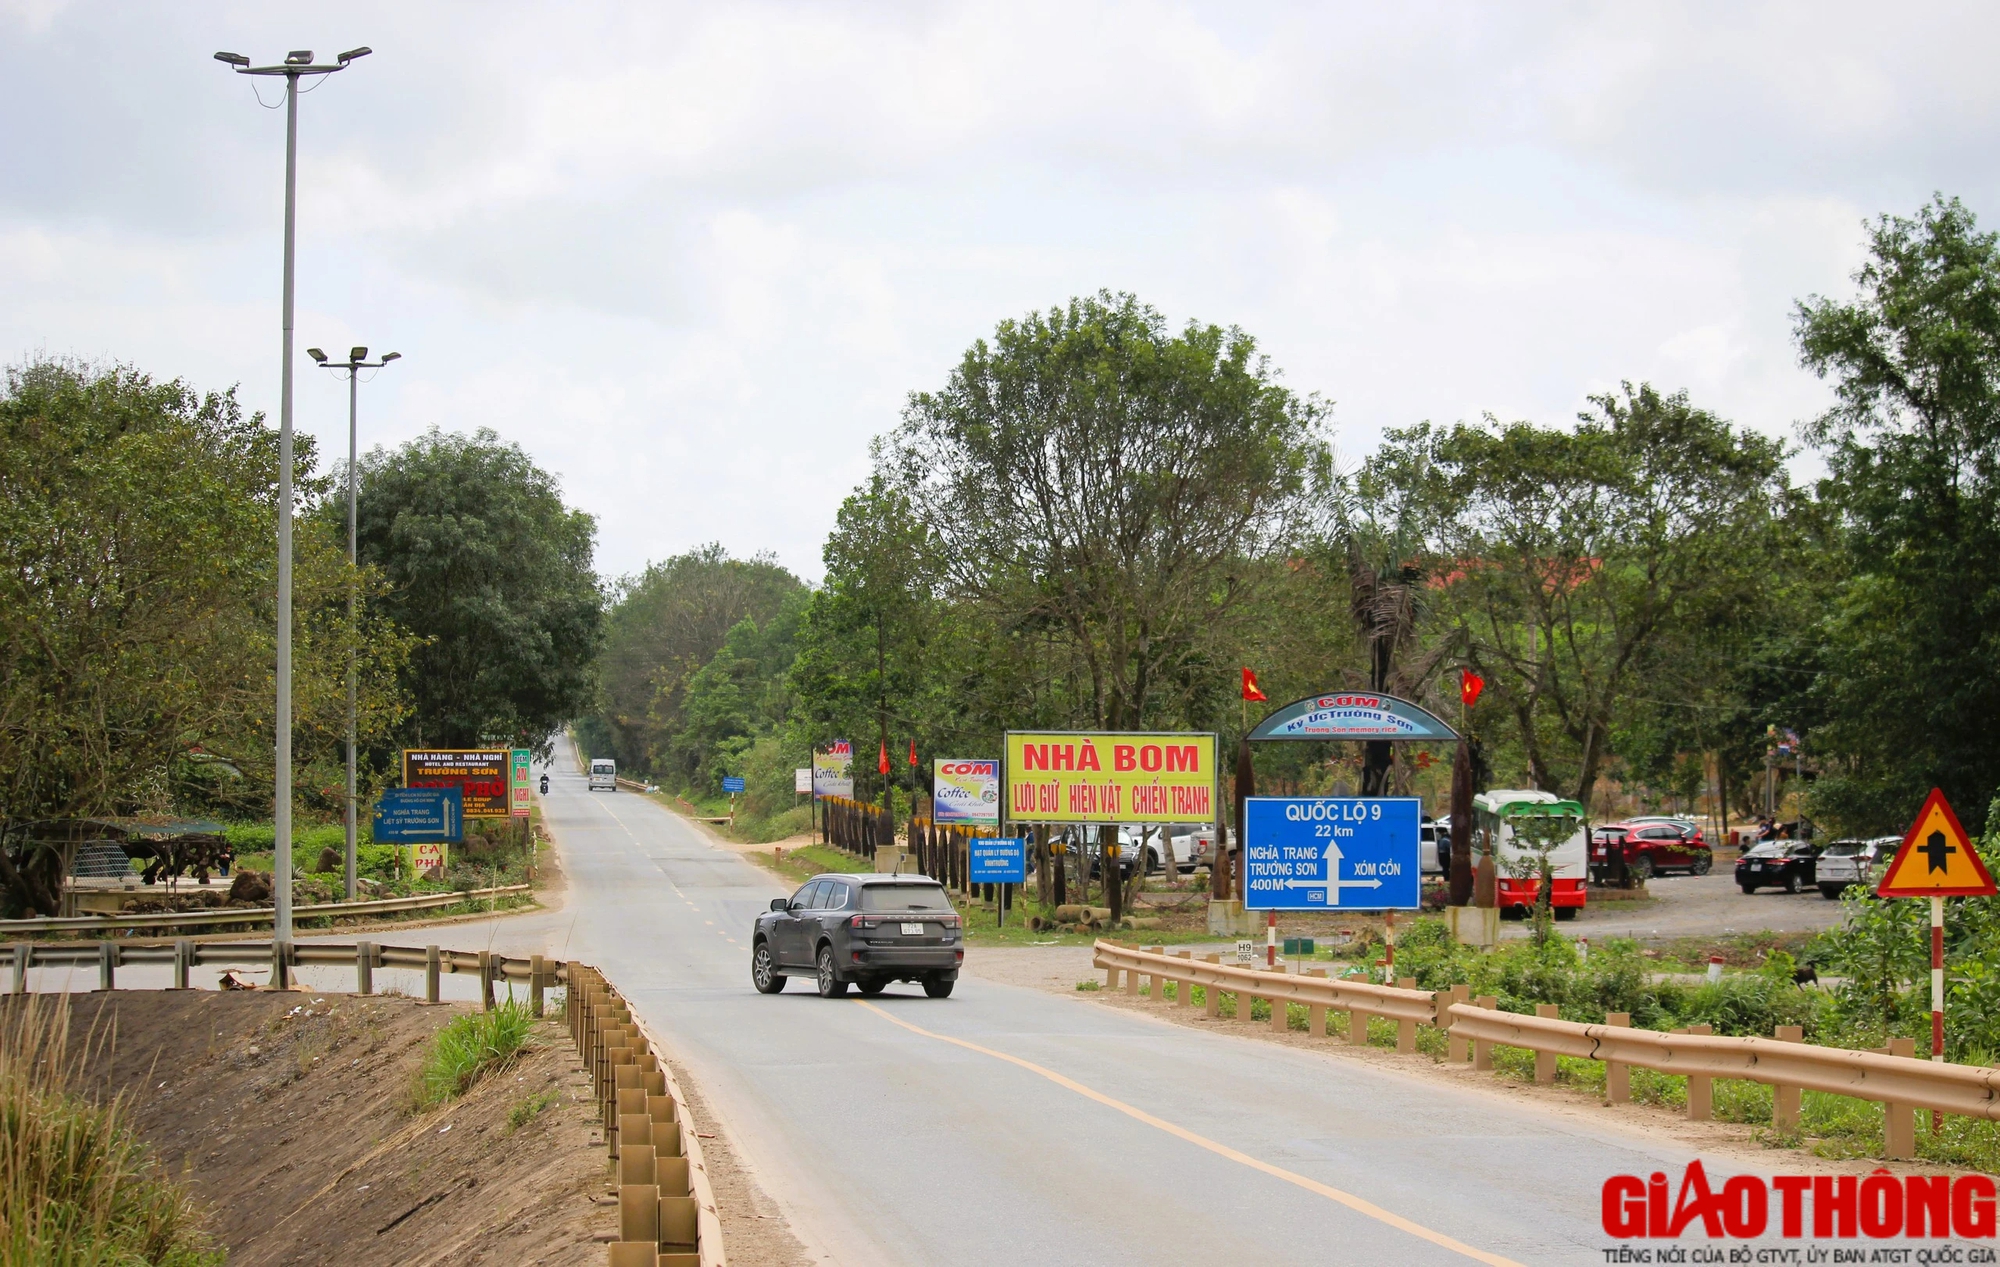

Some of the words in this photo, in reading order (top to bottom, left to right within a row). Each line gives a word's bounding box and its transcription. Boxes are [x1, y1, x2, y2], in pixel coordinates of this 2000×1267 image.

[1318, 696, 1380, 708] CƠM
[1328, 710, 1381, 720] Trường
[1387, 715, 1413, 732] Sơn
[1024, 738, 1101, 772] NHÀ
[1114, 745, 1198, 772] BOM
[418, 767, 468, 775] TRƯỜNG
[815, 766, 840, 778] Coffee
[941, 761, 993, 776] CƠM
[463, 776, 506, 797] PHỞ
[938, 786, 970, 798] Coffee
[1014, 781, 1036, 812] LƯU
[1039, 778, 1060, 812] GIỮ
[1069, 778, 1097, 820] HIỆN
[1100, 778, 1121, 820] VẬT
[1132, 776, 1167, 814] CHIẾN
[1171, 786, 1209, 814] TRANH
[1286, 801, 1339, 822] QUỐC
[1343, 802, 1367, 824] LỘ
[1371, 804, 1381, 821] 9
[1315, 825, 1331, 837] 22
[1334, 825, 1354, 837] km
[1250, 844, 1279, 860] NGHĨA
[1283, 847, 1318, 860] TRANG
[1250, 860, 1292, 876] TRƯỜNG
[1296, 862, 1317, 876] SƠN
[1354, 860, 1376, 876] XÓM
[1378, 858, 1401, 876] CỒN
